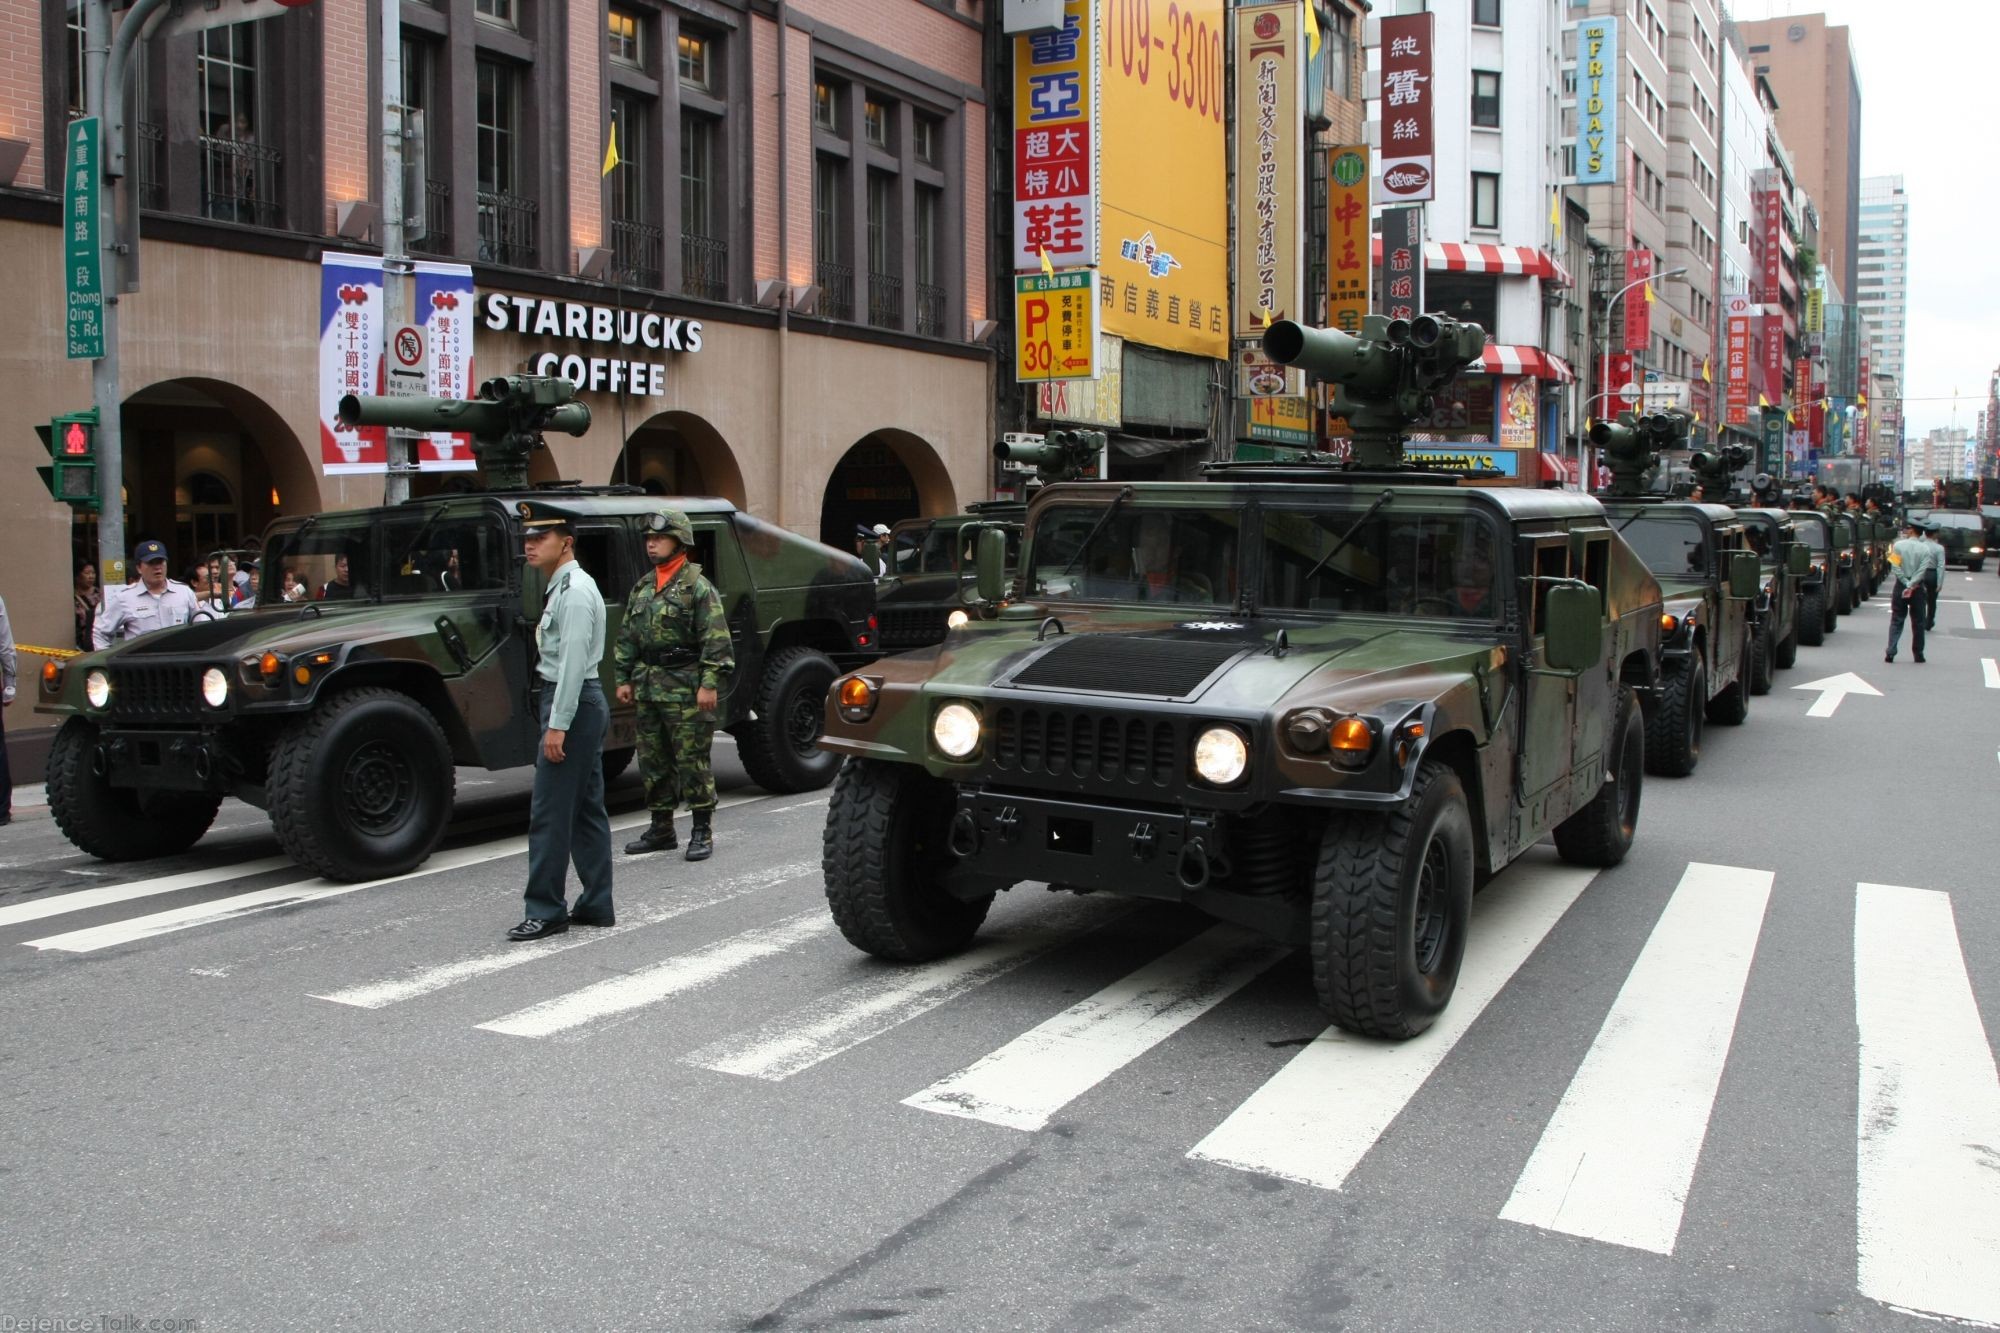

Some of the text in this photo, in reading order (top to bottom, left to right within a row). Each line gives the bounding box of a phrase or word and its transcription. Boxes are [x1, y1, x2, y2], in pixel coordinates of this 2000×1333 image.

[1587, 41, 1604, 174] FRIDAY'S
[1025, 128, 1080, 160] 超大
[1025, 166, 1080, 197] 特小
[74, 144, 90, 287] 重慶南路一段
[1023, 202, 1084, 258] 鞋
[69, 292, 100, 306] Chong
[69, 308, 94, 323] Qing
[70, 323, 100, 337] S. Rd.
[486, 293, 703, 353] STARBUCKS
[1025, 299, 1050, 338] P
[1062, 295, 1073, 351] 免費停車
[70, 342, 99, 354] Sec. 1
[1024, 340, 1053, 372] 30
[537, 352, 666, 397] COFFEE
